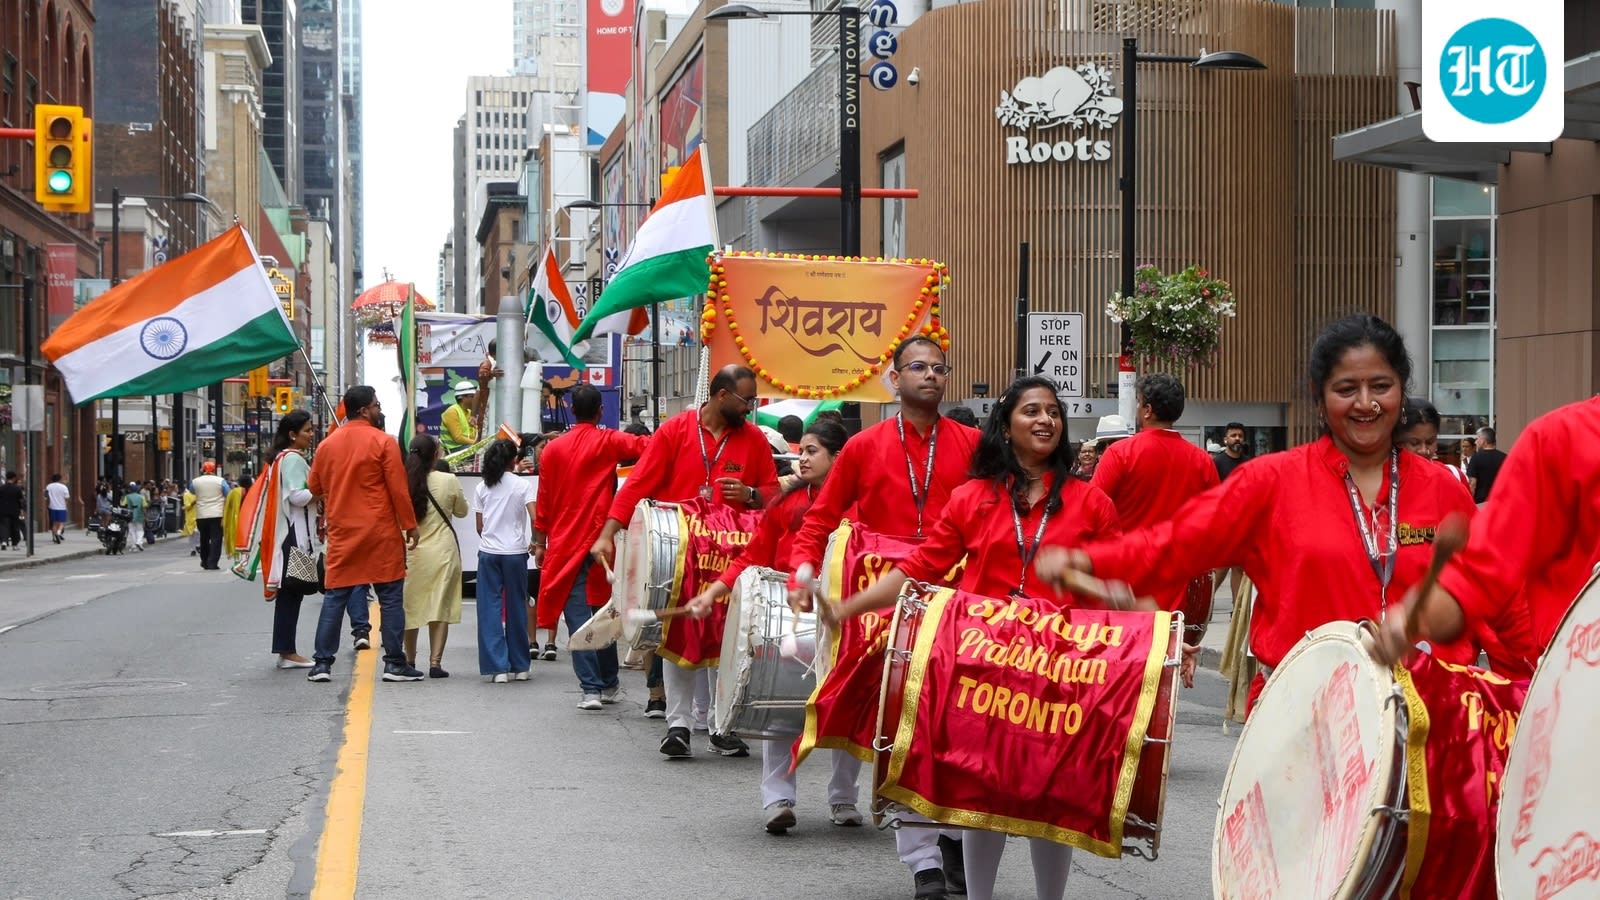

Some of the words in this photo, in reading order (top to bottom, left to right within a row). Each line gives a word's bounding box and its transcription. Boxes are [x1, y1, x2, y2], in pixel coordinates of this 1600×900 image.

[597, 27, 617, 35] HOME
[618, 26, 628, 34] OF
[846, 17, 857, 128] DOWNTOWN
[1006, 136, 1111, 164] Roots
[755, 285, 888, 365] शिवराय
[1041, 319, 1070, 330] STOP
[1039, 335, 1071, 346] HERE
[1061, 350, 1078, 361] ON
[1054, 365, 1078, 376] RED
[1054, 380, 1077, 391] NAL
[125, 432, 144, 441] 221
[956, 675, 1083, 735] TORONTO
